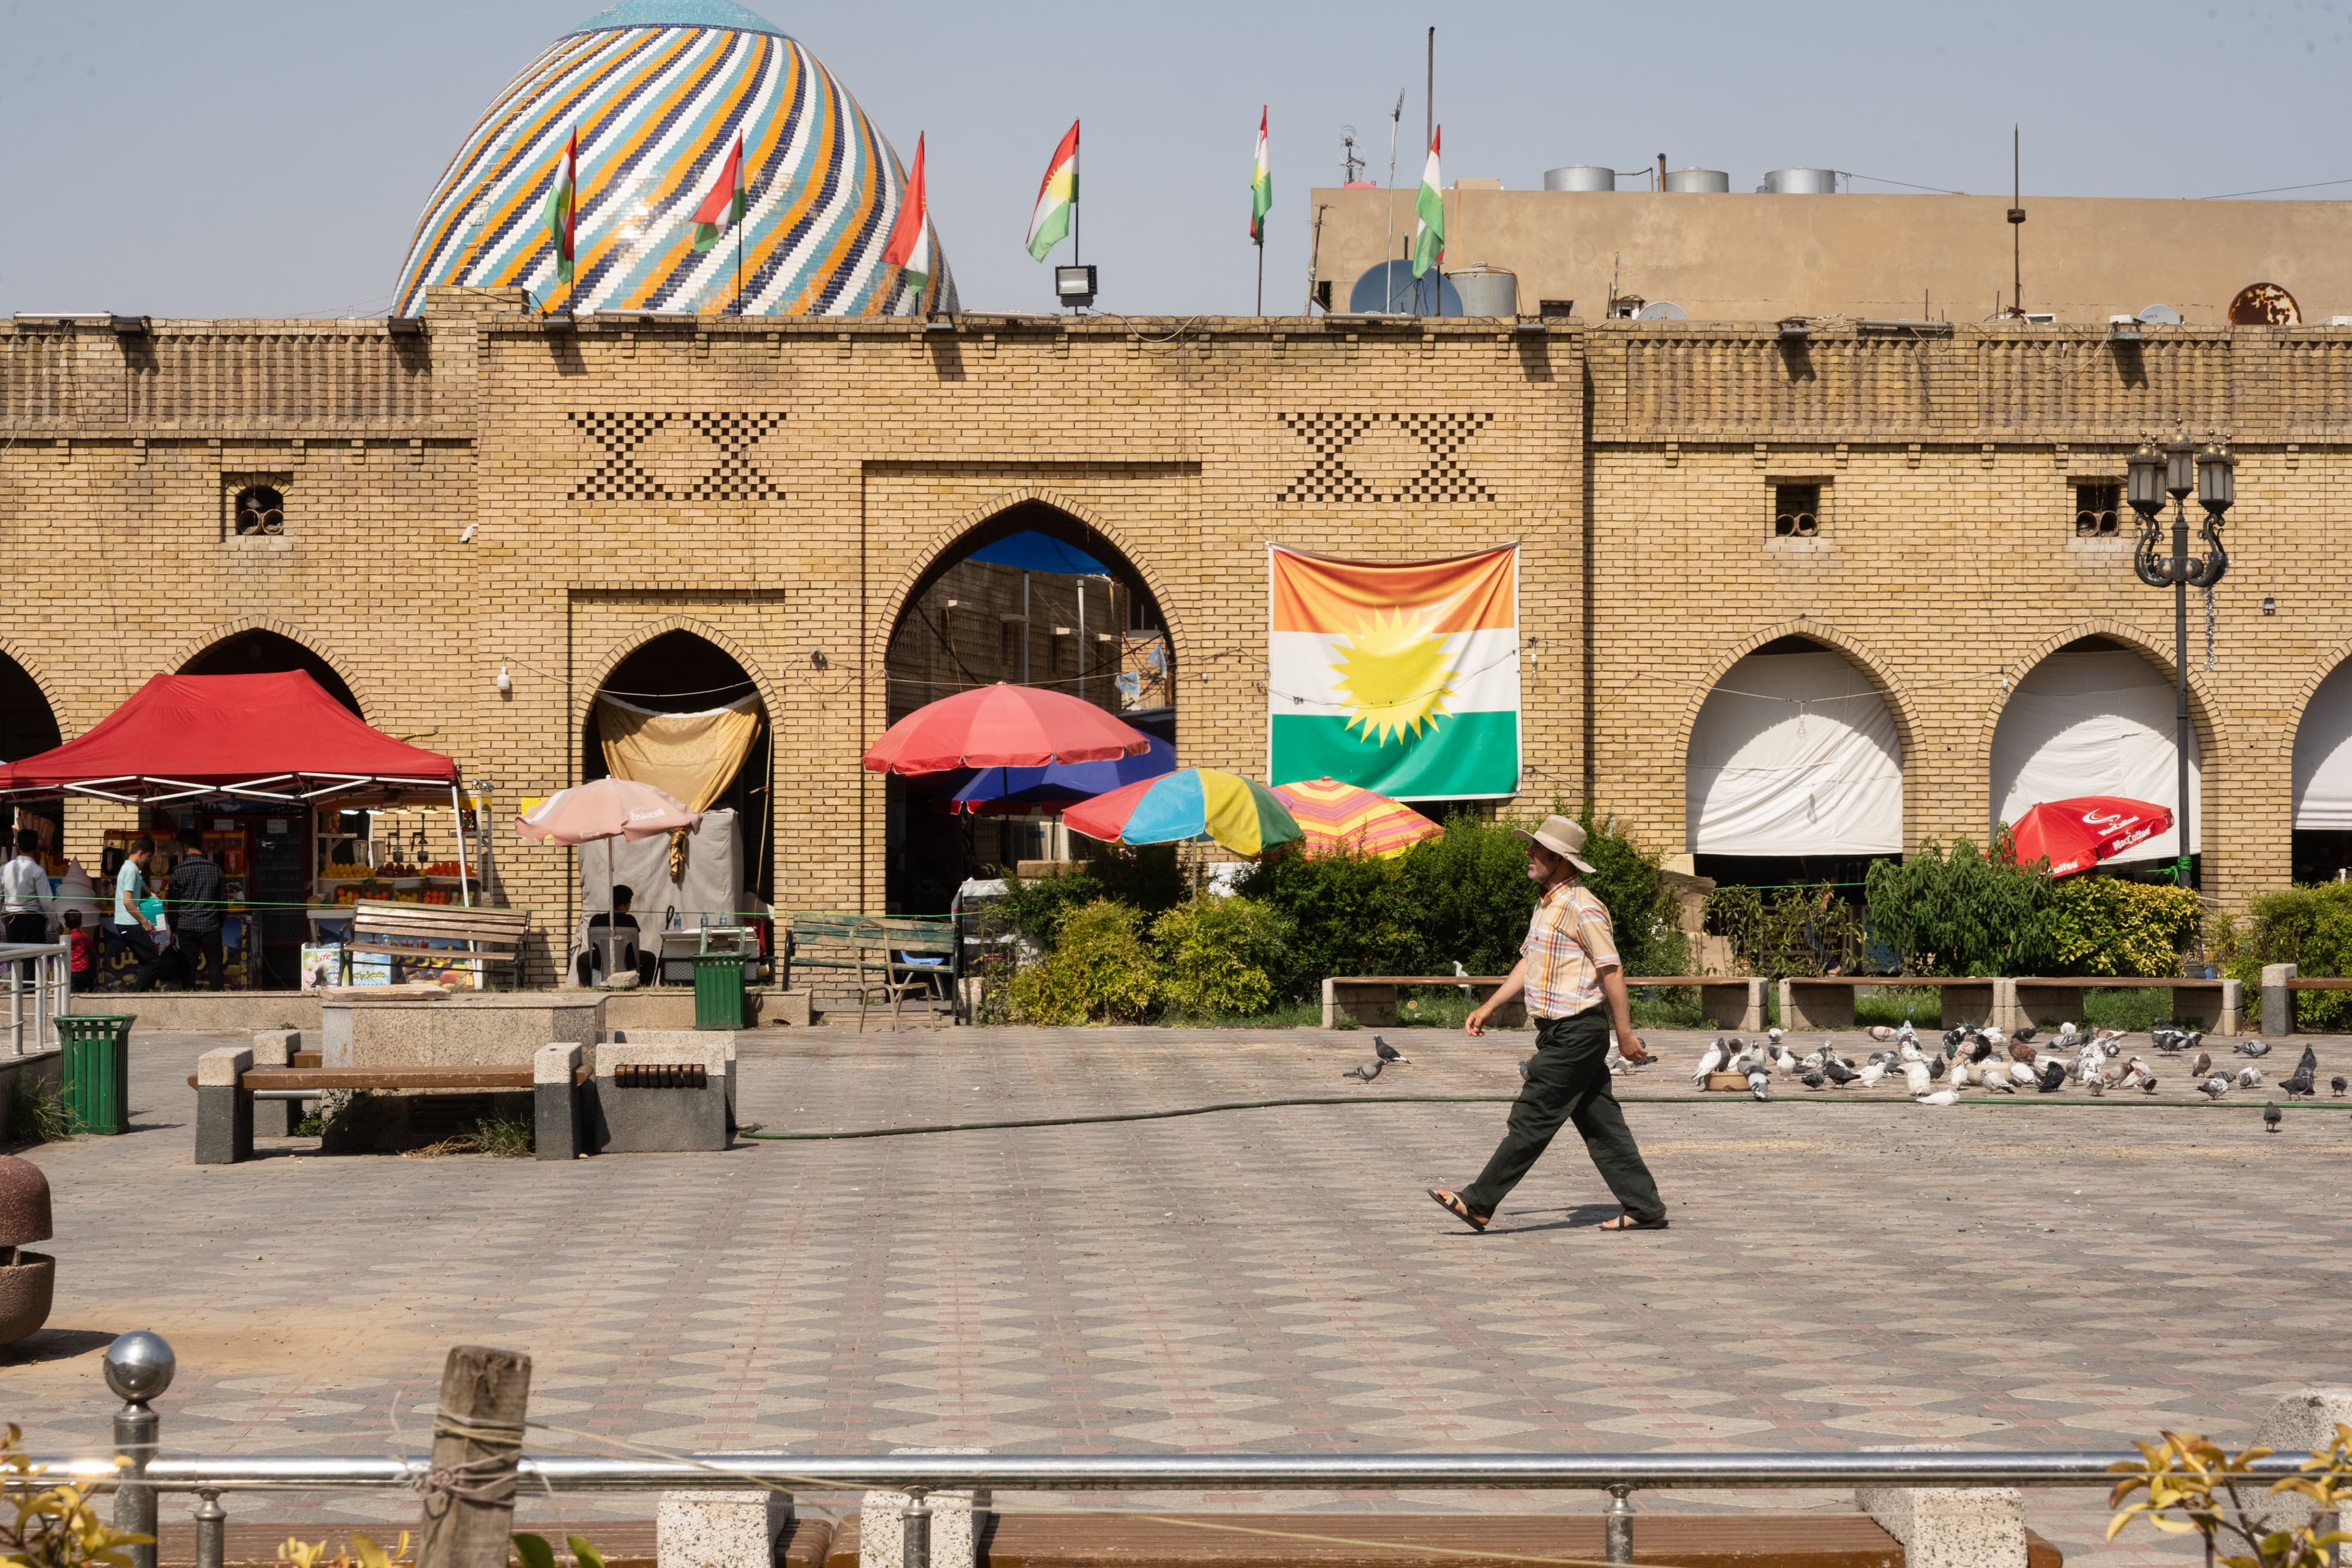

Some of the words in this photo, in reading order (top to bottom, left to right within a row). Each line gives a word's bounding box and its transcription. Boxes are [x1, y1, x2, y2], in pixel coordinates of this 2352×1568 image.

[628, 808, 666, 821] Asiacell
[2097, 816, 2139, 835] MacCoffee
[2113, 827, 2150, 851] MacCoffee
[315, 953, 331, 962] Life
